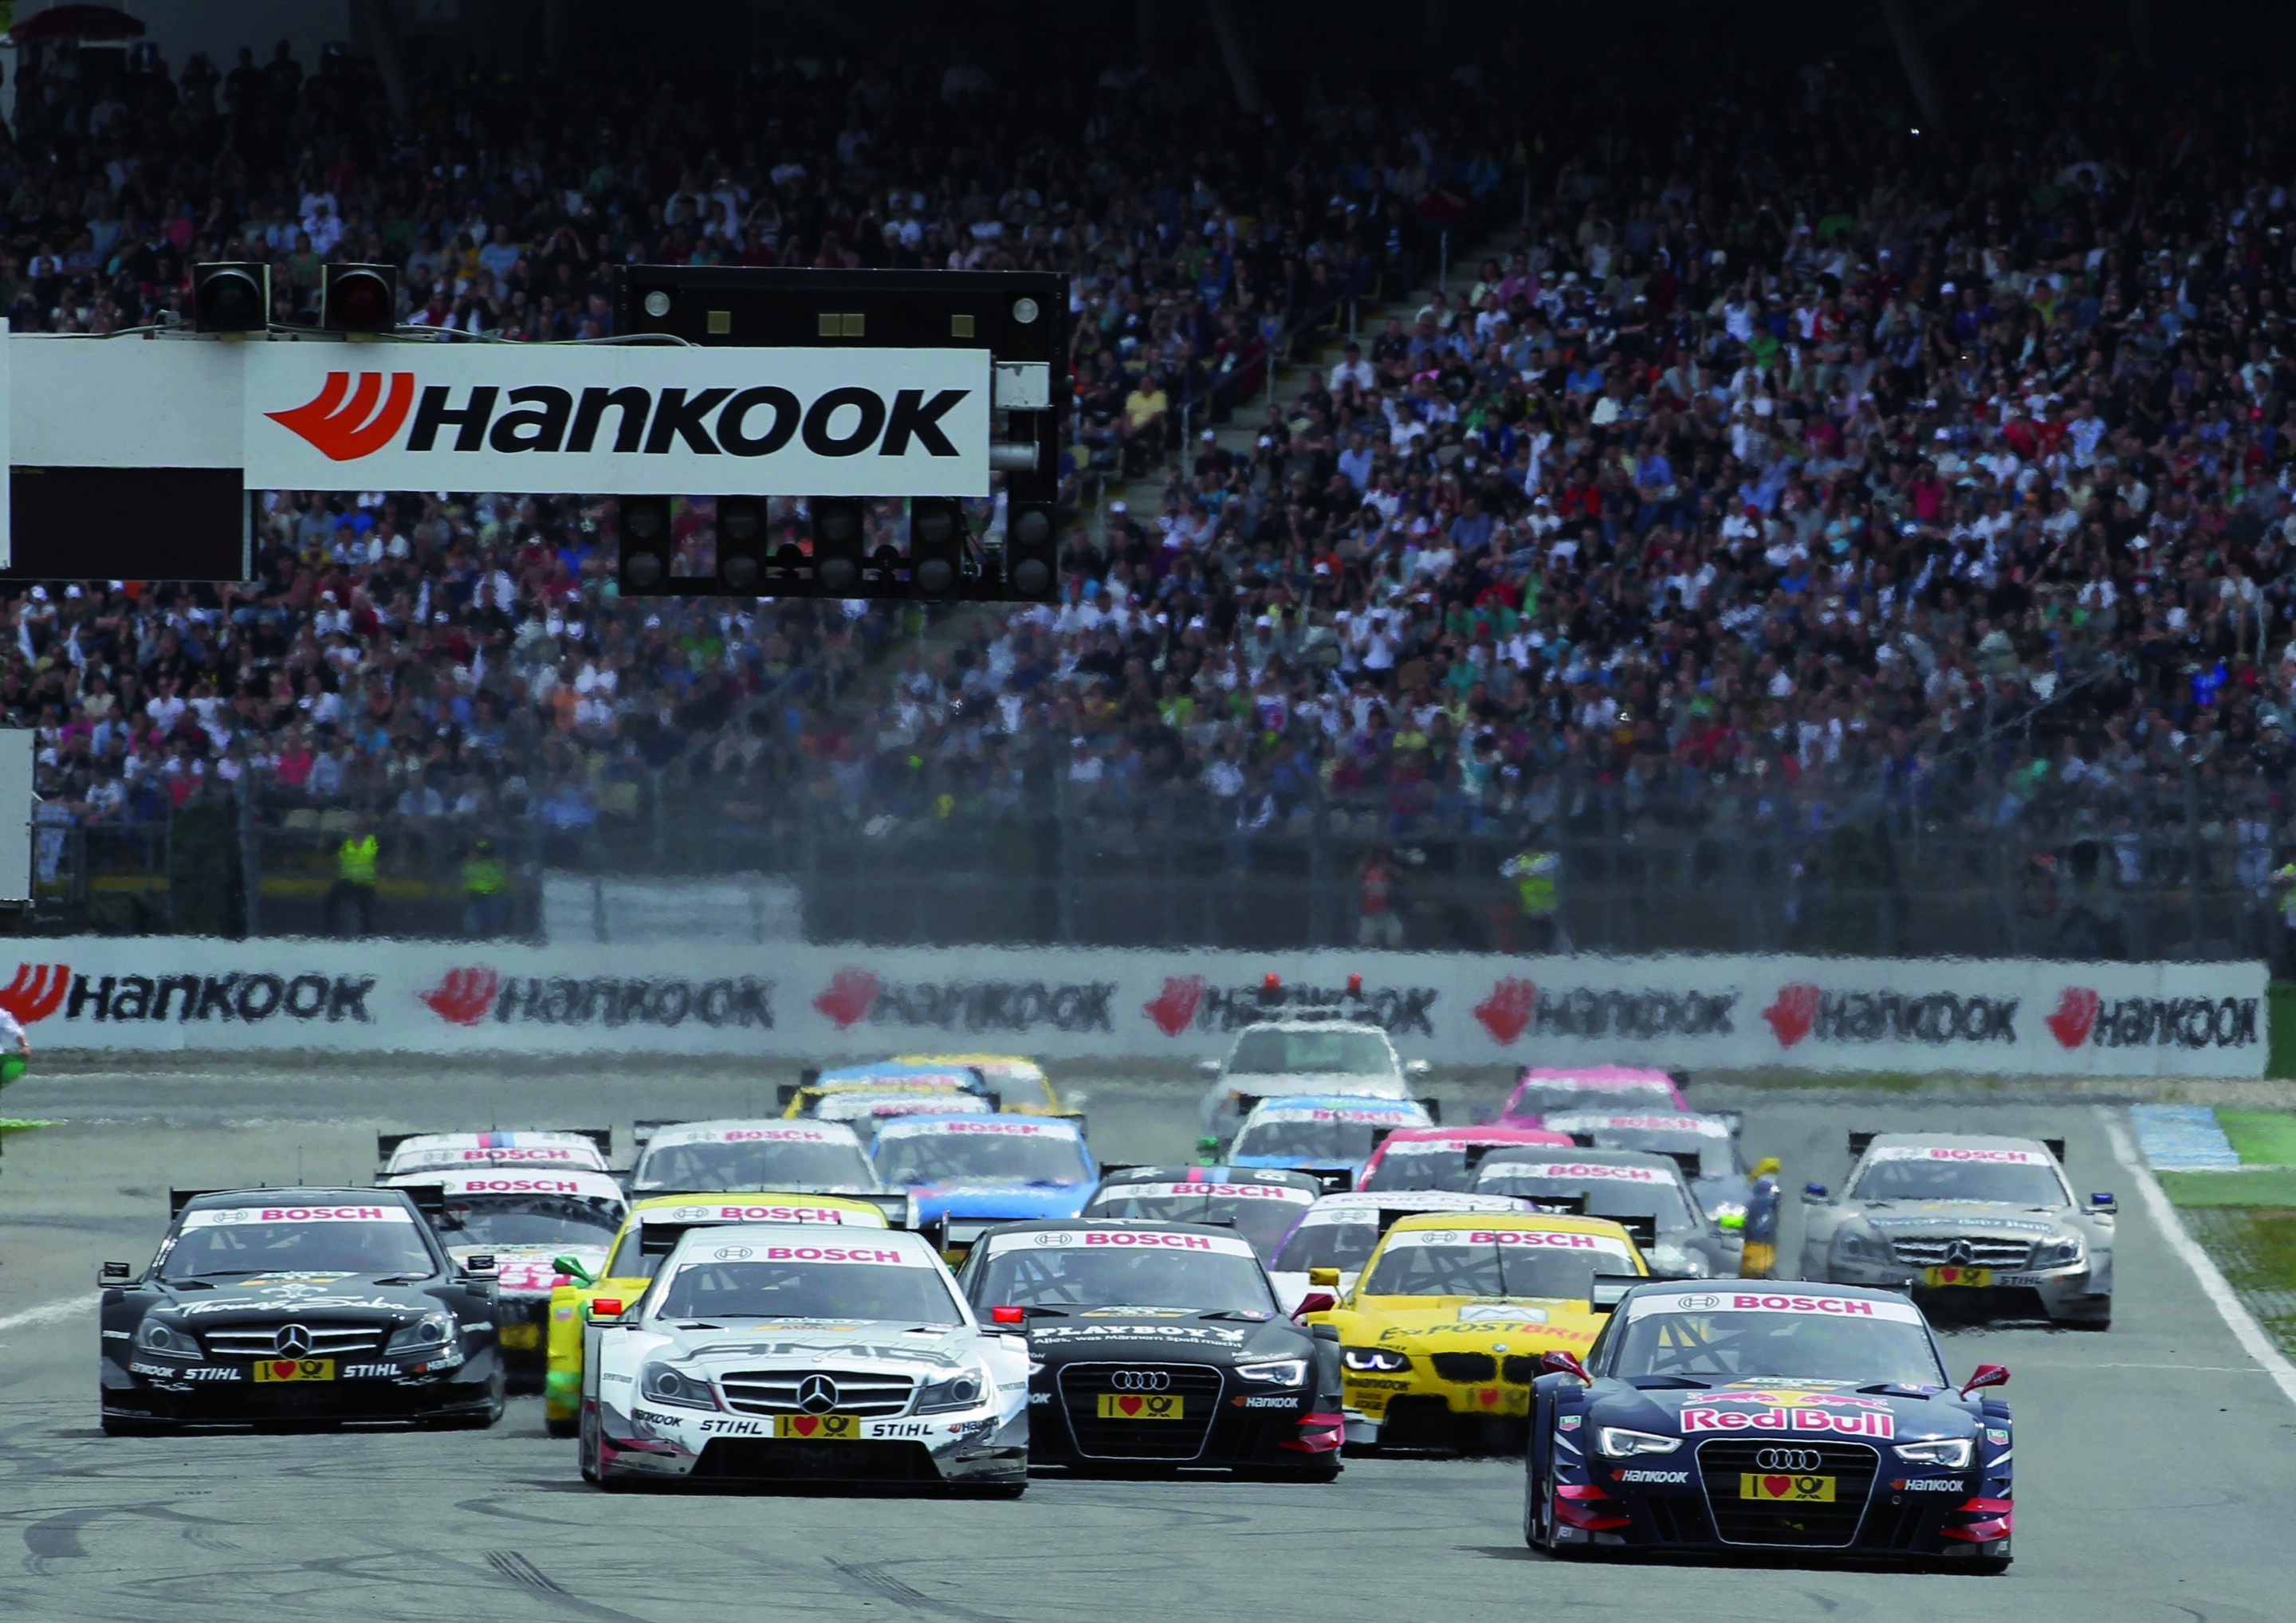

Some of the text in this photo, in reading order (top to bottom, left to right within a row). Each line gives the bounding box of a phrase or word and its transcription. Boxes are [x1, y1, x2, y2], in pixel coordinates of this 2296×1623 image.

[947, 1121, 1039, 1134] BOSCH
[725, 1130, 822, 1141] BOSCH
[464, 1149, 569, 1161] BOSCH
[1930, 1148, 2027, 1161] BOSCH
[1548, 1165, 1651, 1180] BOSCH
[466, 1181, 578, 1192] BOSCH
[1172, 1181, 1284, 1197] BOSCH
[261, 1208, 383, 1220] BOSCH
[721, 1207, 841, 1221] BOSCH
[1086, 1232, 1211, 1250] BOSCH
[1471, 1232, 1595, 1248] BOSCH
[768, 1248, 902, 1263] BOSCH
[2000, 1276, 2044, 1286] STIHL
[1733, 1295, 1872, 1315] BOSCH
[1032, 1325, 1209, 1338] PLAYBOY
[1201, 1338, 1244, 1349] macht
[183, 1367, 242, 1381] STIHL
[343, 1363, 403, 1378] STIHL
[700, 1419, 764, 1435] STIHL
[872, 1423, 934, 1436] STIHL
[1681, 1408, 1894, 1440] Red Bull
